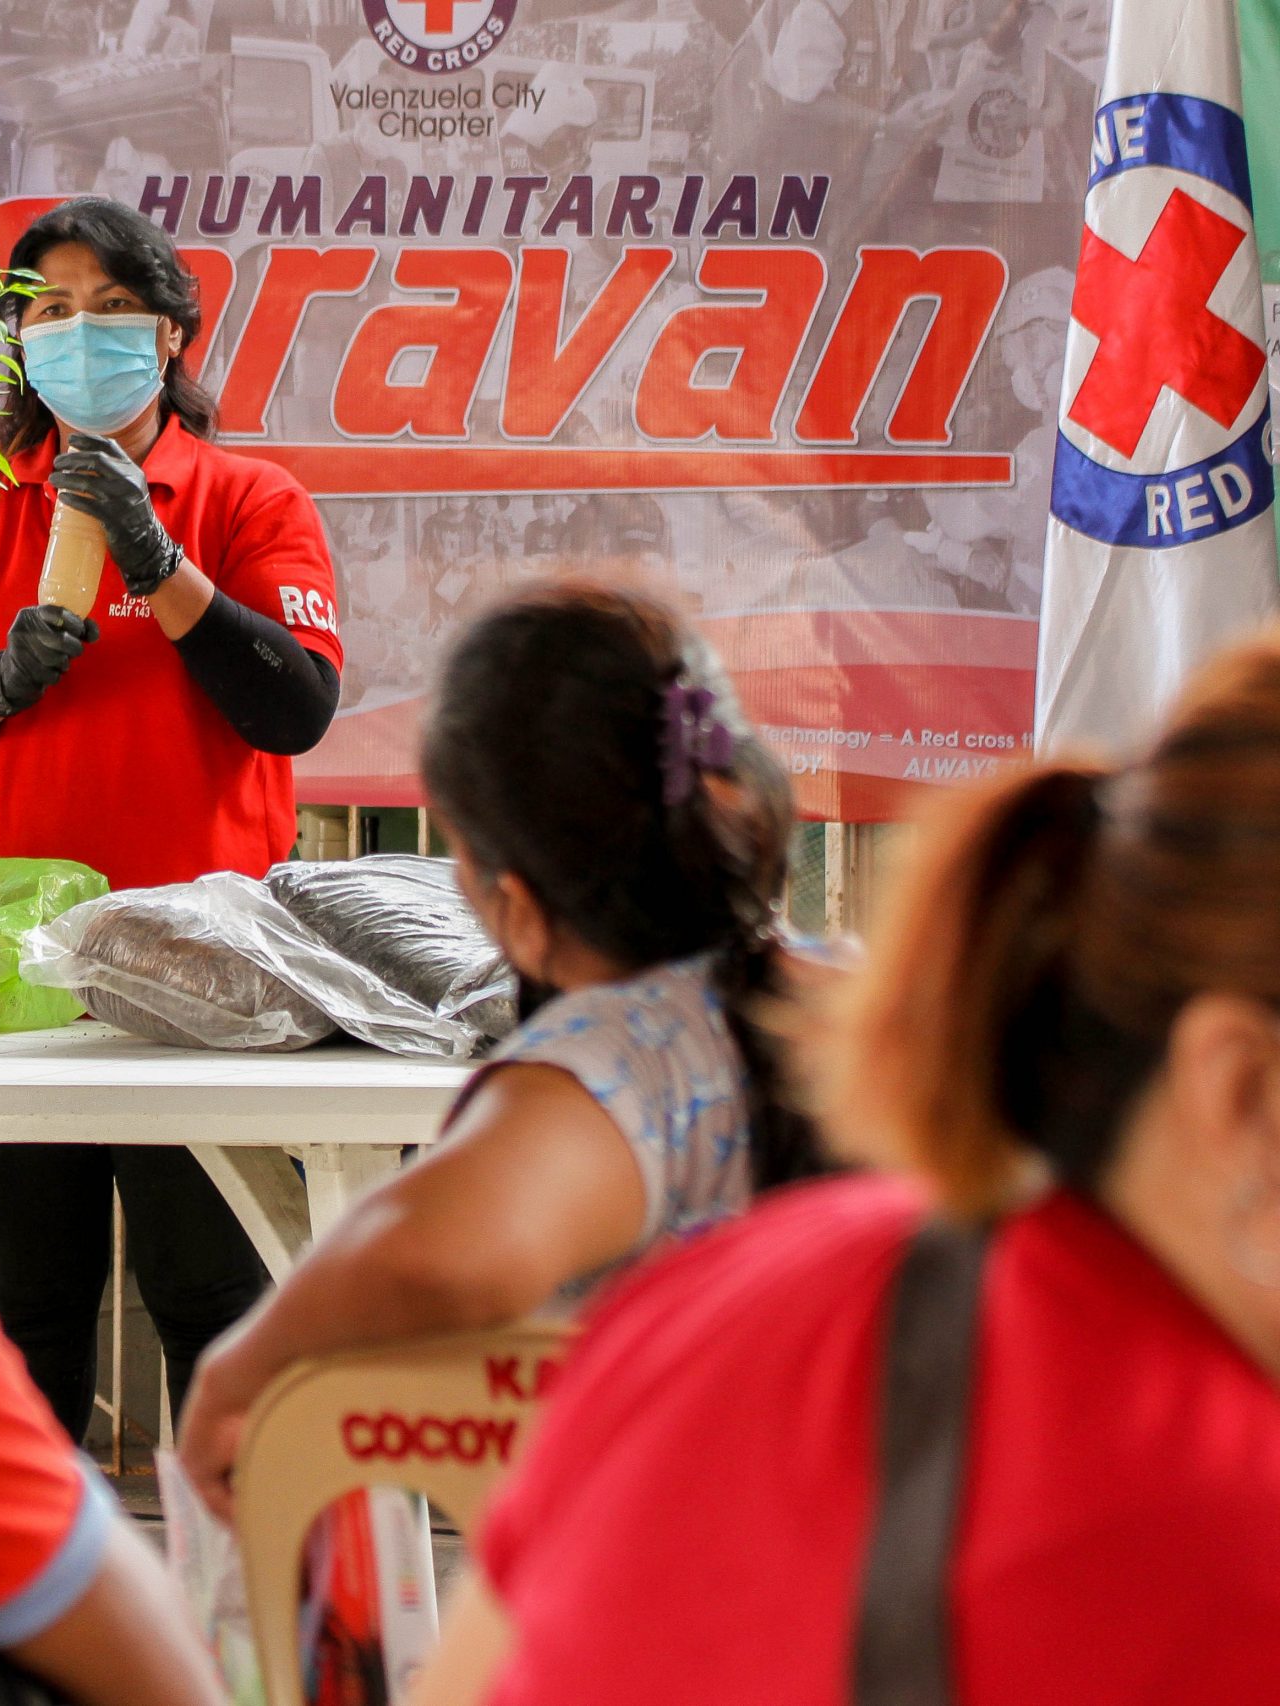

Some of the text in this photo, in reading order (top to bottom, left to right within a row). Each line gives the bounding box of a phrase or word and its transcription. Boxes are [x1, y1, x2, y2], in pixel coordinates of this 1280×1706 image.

[373, 16, 505, 72] RED CROSS
[329, 82, 546, 115] Valenzuela City
[378, 110, 495, 141] Chapter
[137, 174, 832, 240] HUMANITARIAN
[1145, 463, 1254, 538] RED
[108, 603, 150, 618] RCAT 143
[760, 726, 872, 749] Technology
[901, 729, 916, 747] A
[921, 729, 959, 748] Red
[965, 734, 1015, 749] cross
[903, 757, 1000, 780] ALWAYS
[341, 1410, 517, 1465] COCOY
